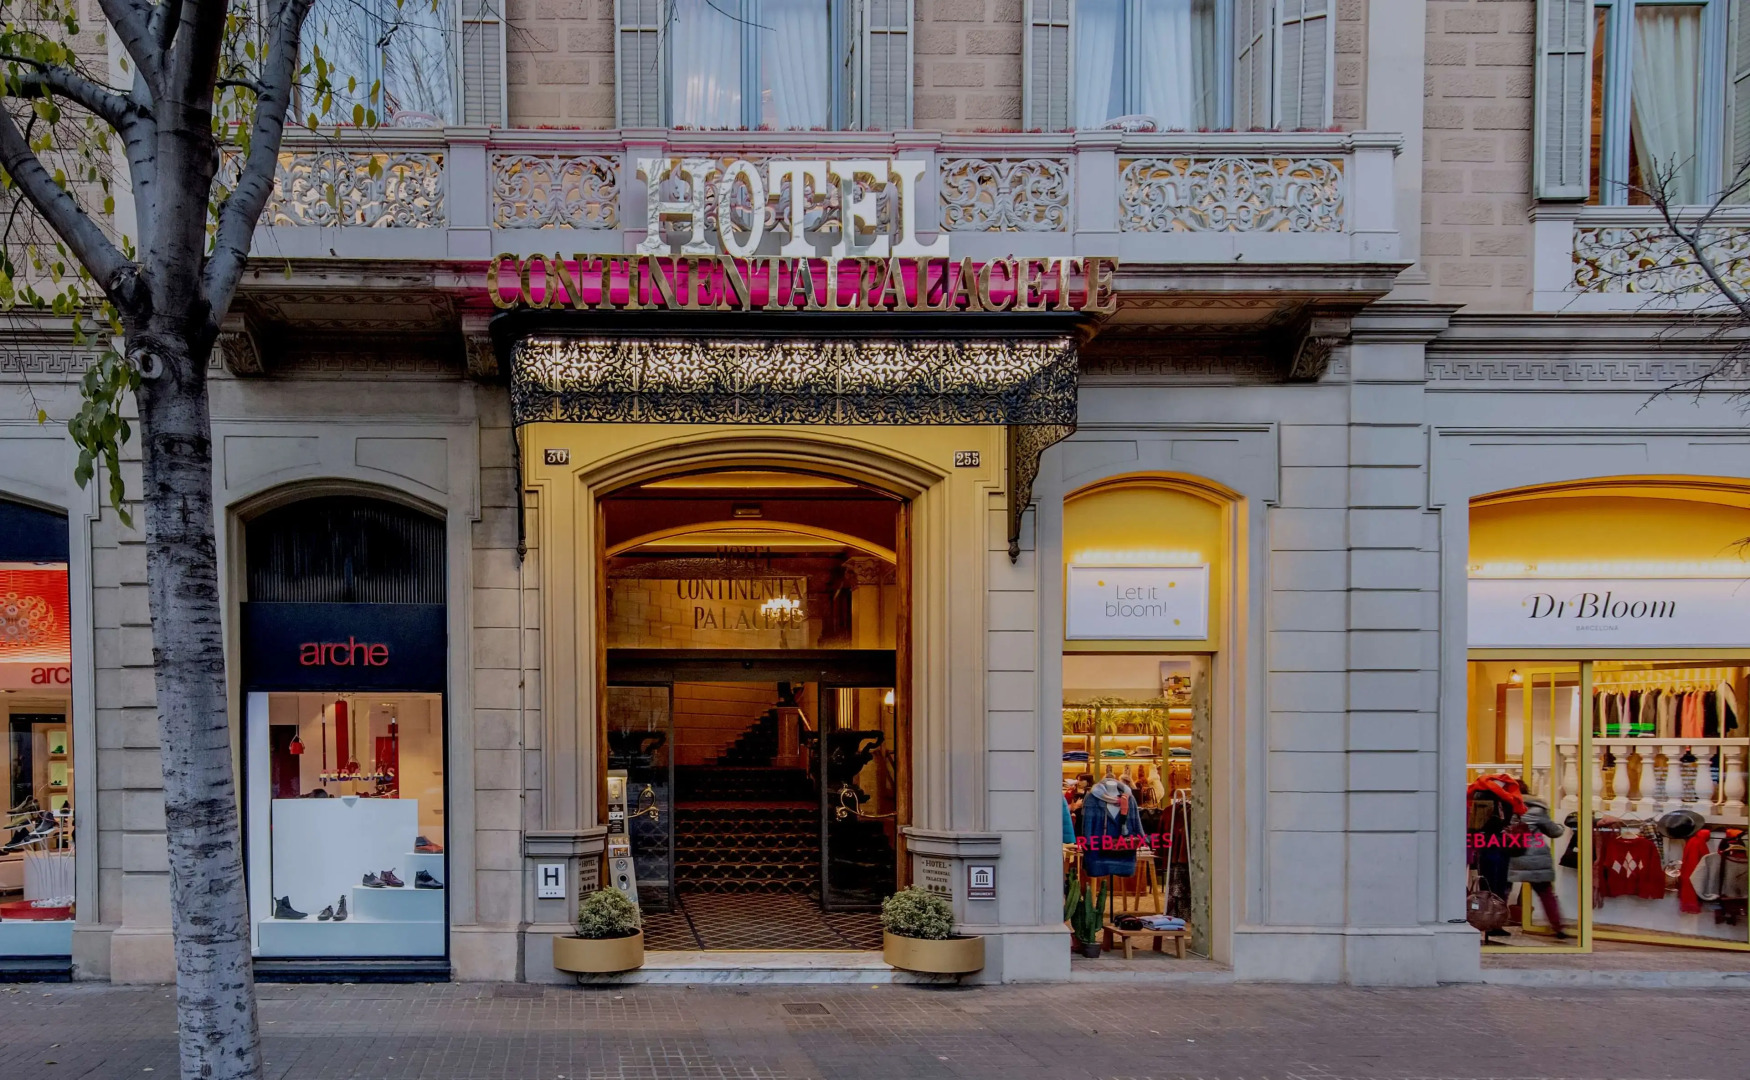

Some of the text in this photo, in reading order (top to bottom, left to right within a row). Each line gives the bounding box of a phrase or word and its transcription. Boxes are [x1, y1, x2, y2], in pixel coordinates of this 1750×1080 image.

[636, 158, 949, 257] HOTEL
[487, 252, 1119, 311] CONTINENTAL PALACETE
[547, 450, 567, 463] 30
[956, 452, 979, 466] 255
[1116, 584, 1158, 600] Let it
[1105, 601, 1167, 617] bloom!
[1522, 591, 1676, 619] Dr Bloom
[694, 606, 801, 630] PALACETE
[300, 636, 389, 666] arche
[319, 768, 395, 782] REBAJAS
[1076, 833, 1173, 851] REBAIXES
[925, 860, 947, 868] HOTEL
[544, 868, 559, 886] H
